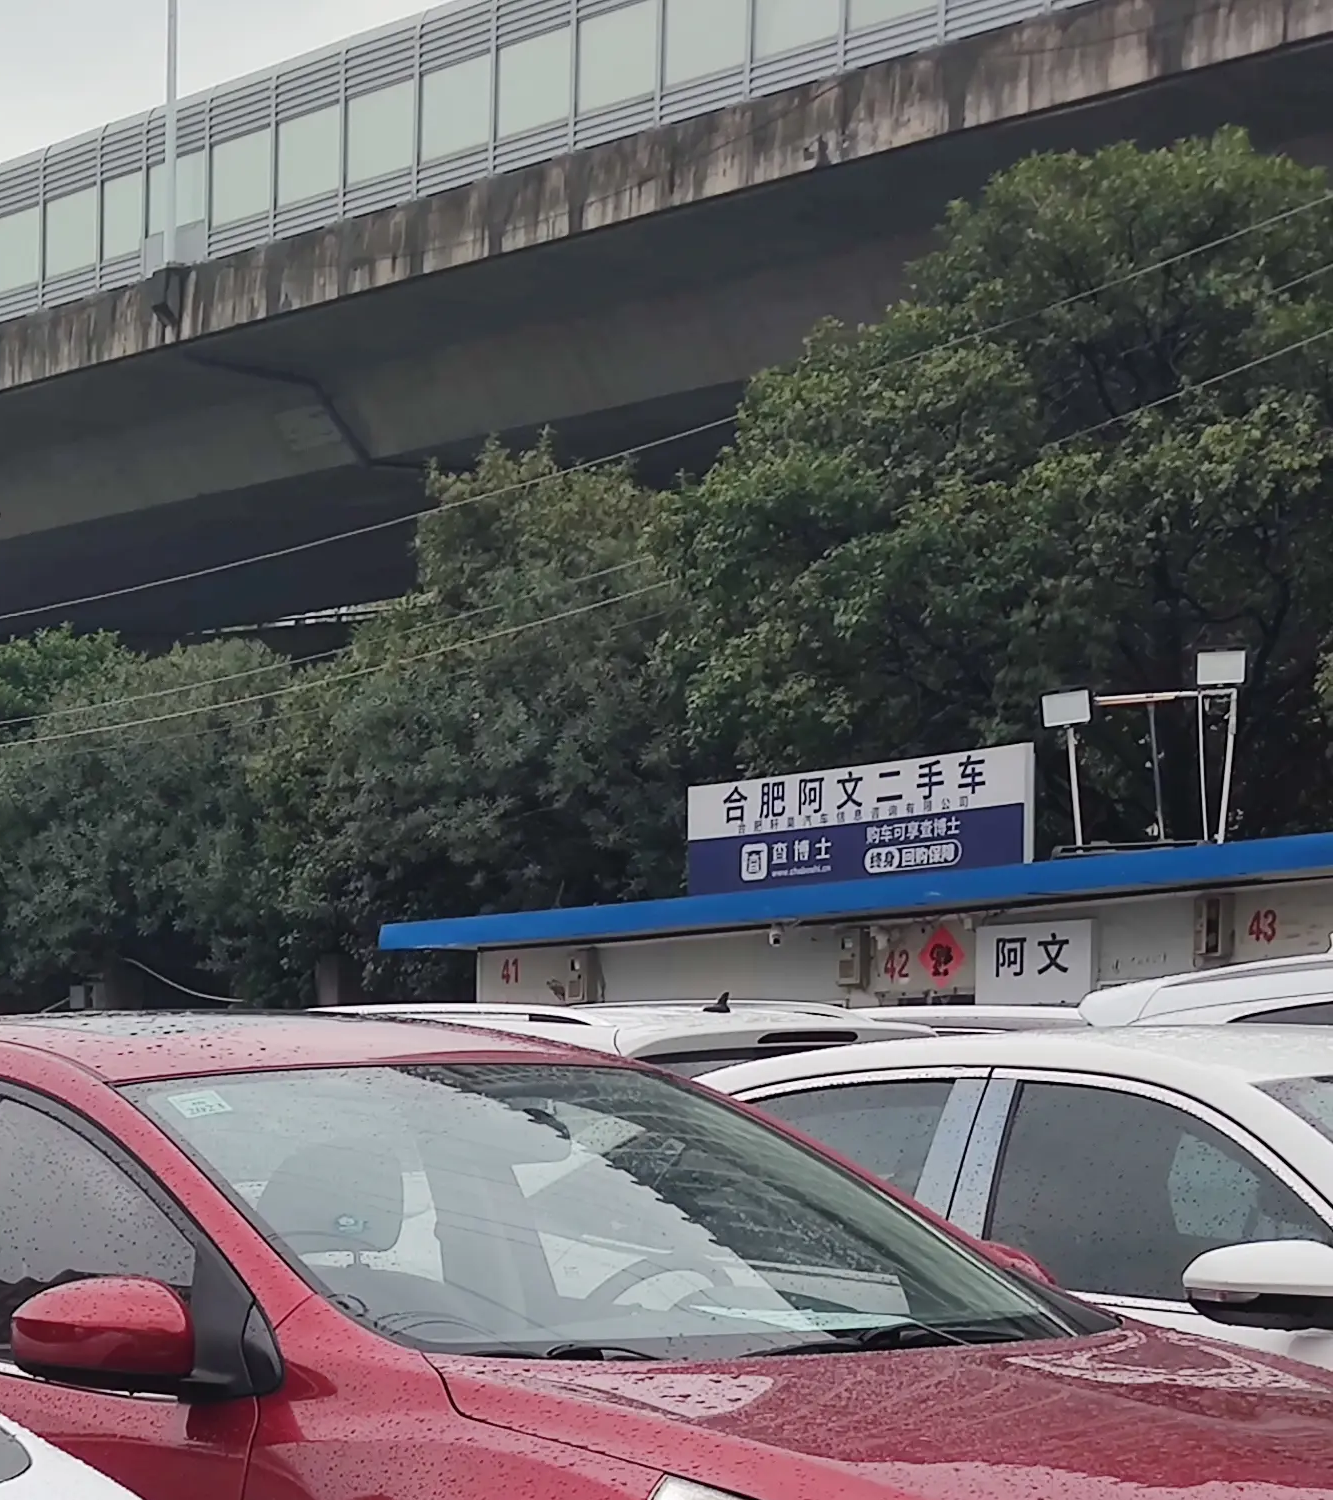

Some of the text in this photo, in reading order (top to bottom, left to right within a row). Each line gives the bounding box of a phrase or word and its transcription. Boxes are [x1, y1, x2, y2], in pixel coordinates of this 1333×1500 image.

[723, 755, 986, 824] 合肥阿文二手车
[865, 816, 961, 845] 购车可享查博士
[771, 836, 832, 864] 查博士
[1248, 909, 1277, 944] 43
[884, 949, 910, 979] 42
[995, 932, 1070, 977] 阿文
[501, 958, 519, 985] 41
